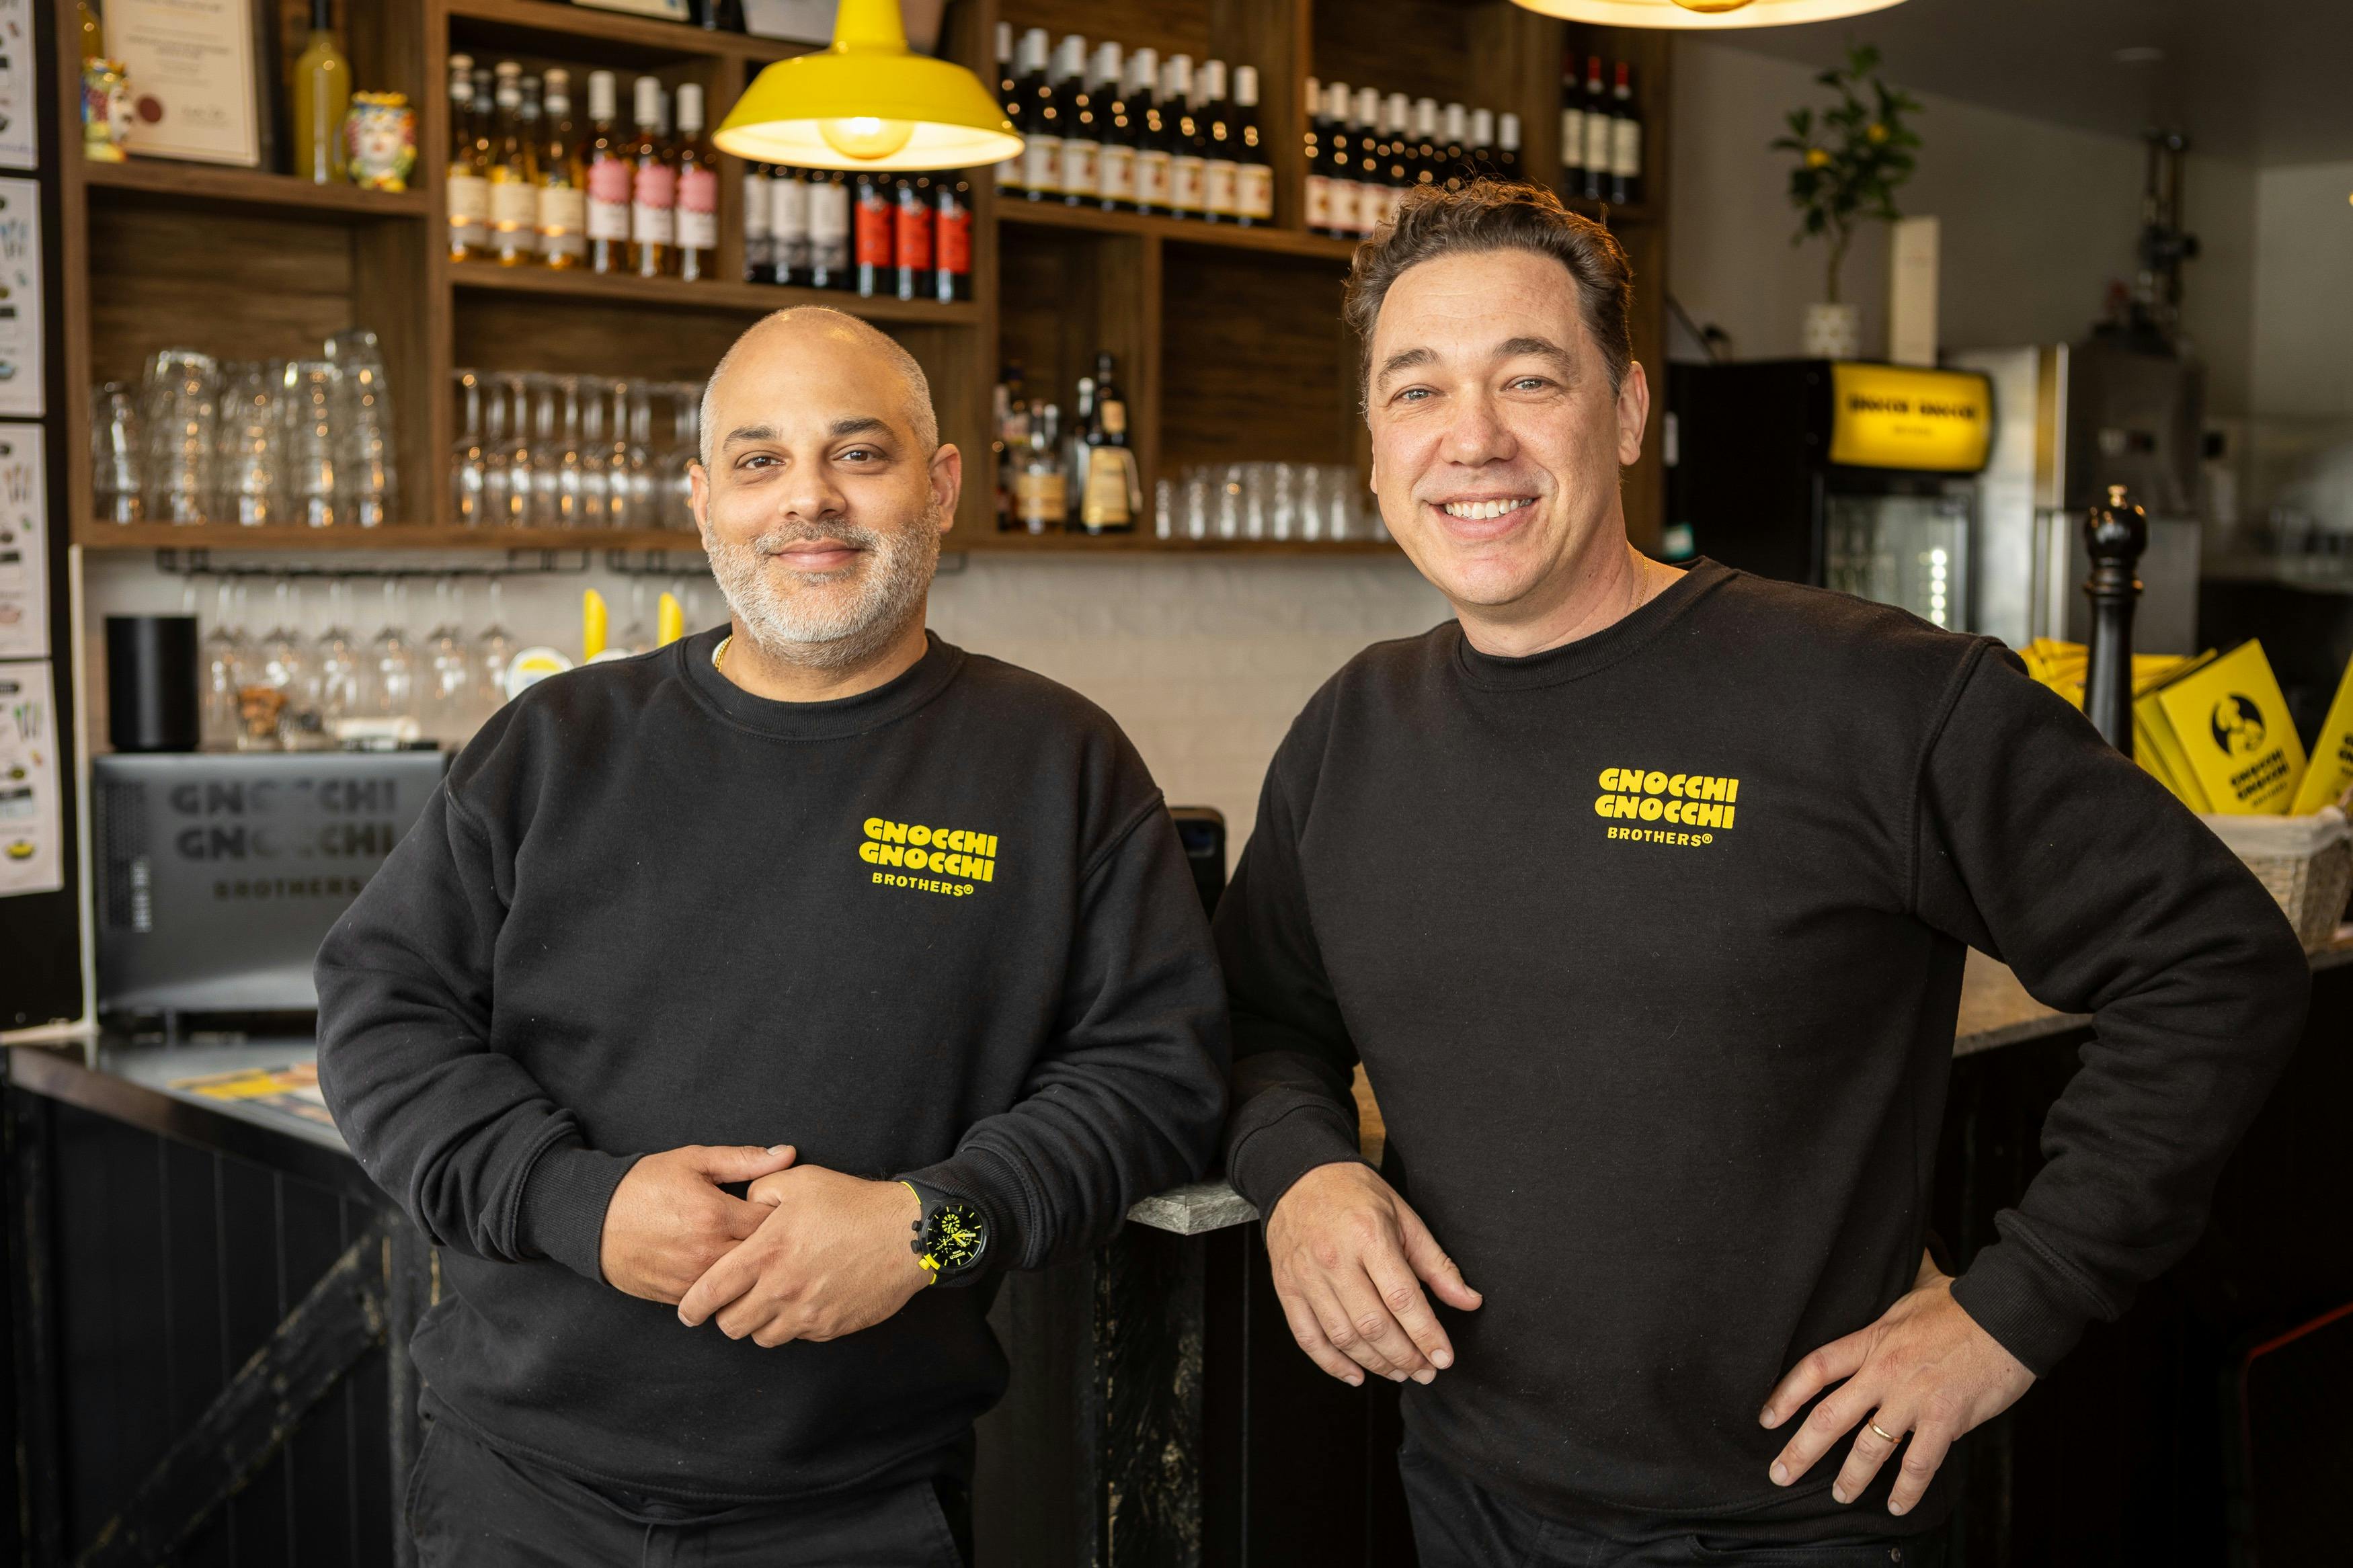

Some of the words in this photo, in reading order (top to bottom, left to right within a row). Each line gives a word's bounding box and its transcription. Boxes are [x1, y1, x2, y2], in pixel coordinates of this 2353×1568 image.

[169, 778, 395, 815] GNCHI
[1599, 768, 1739, 803] GNOCCHI
[1594, 794, 1736, 829] GNOCCHI
[177, 824, 395, 860] GNCHI
[863, 817, 998, 858] GNOCCHI
[859, 841, 995, 882] GNOCCHI
